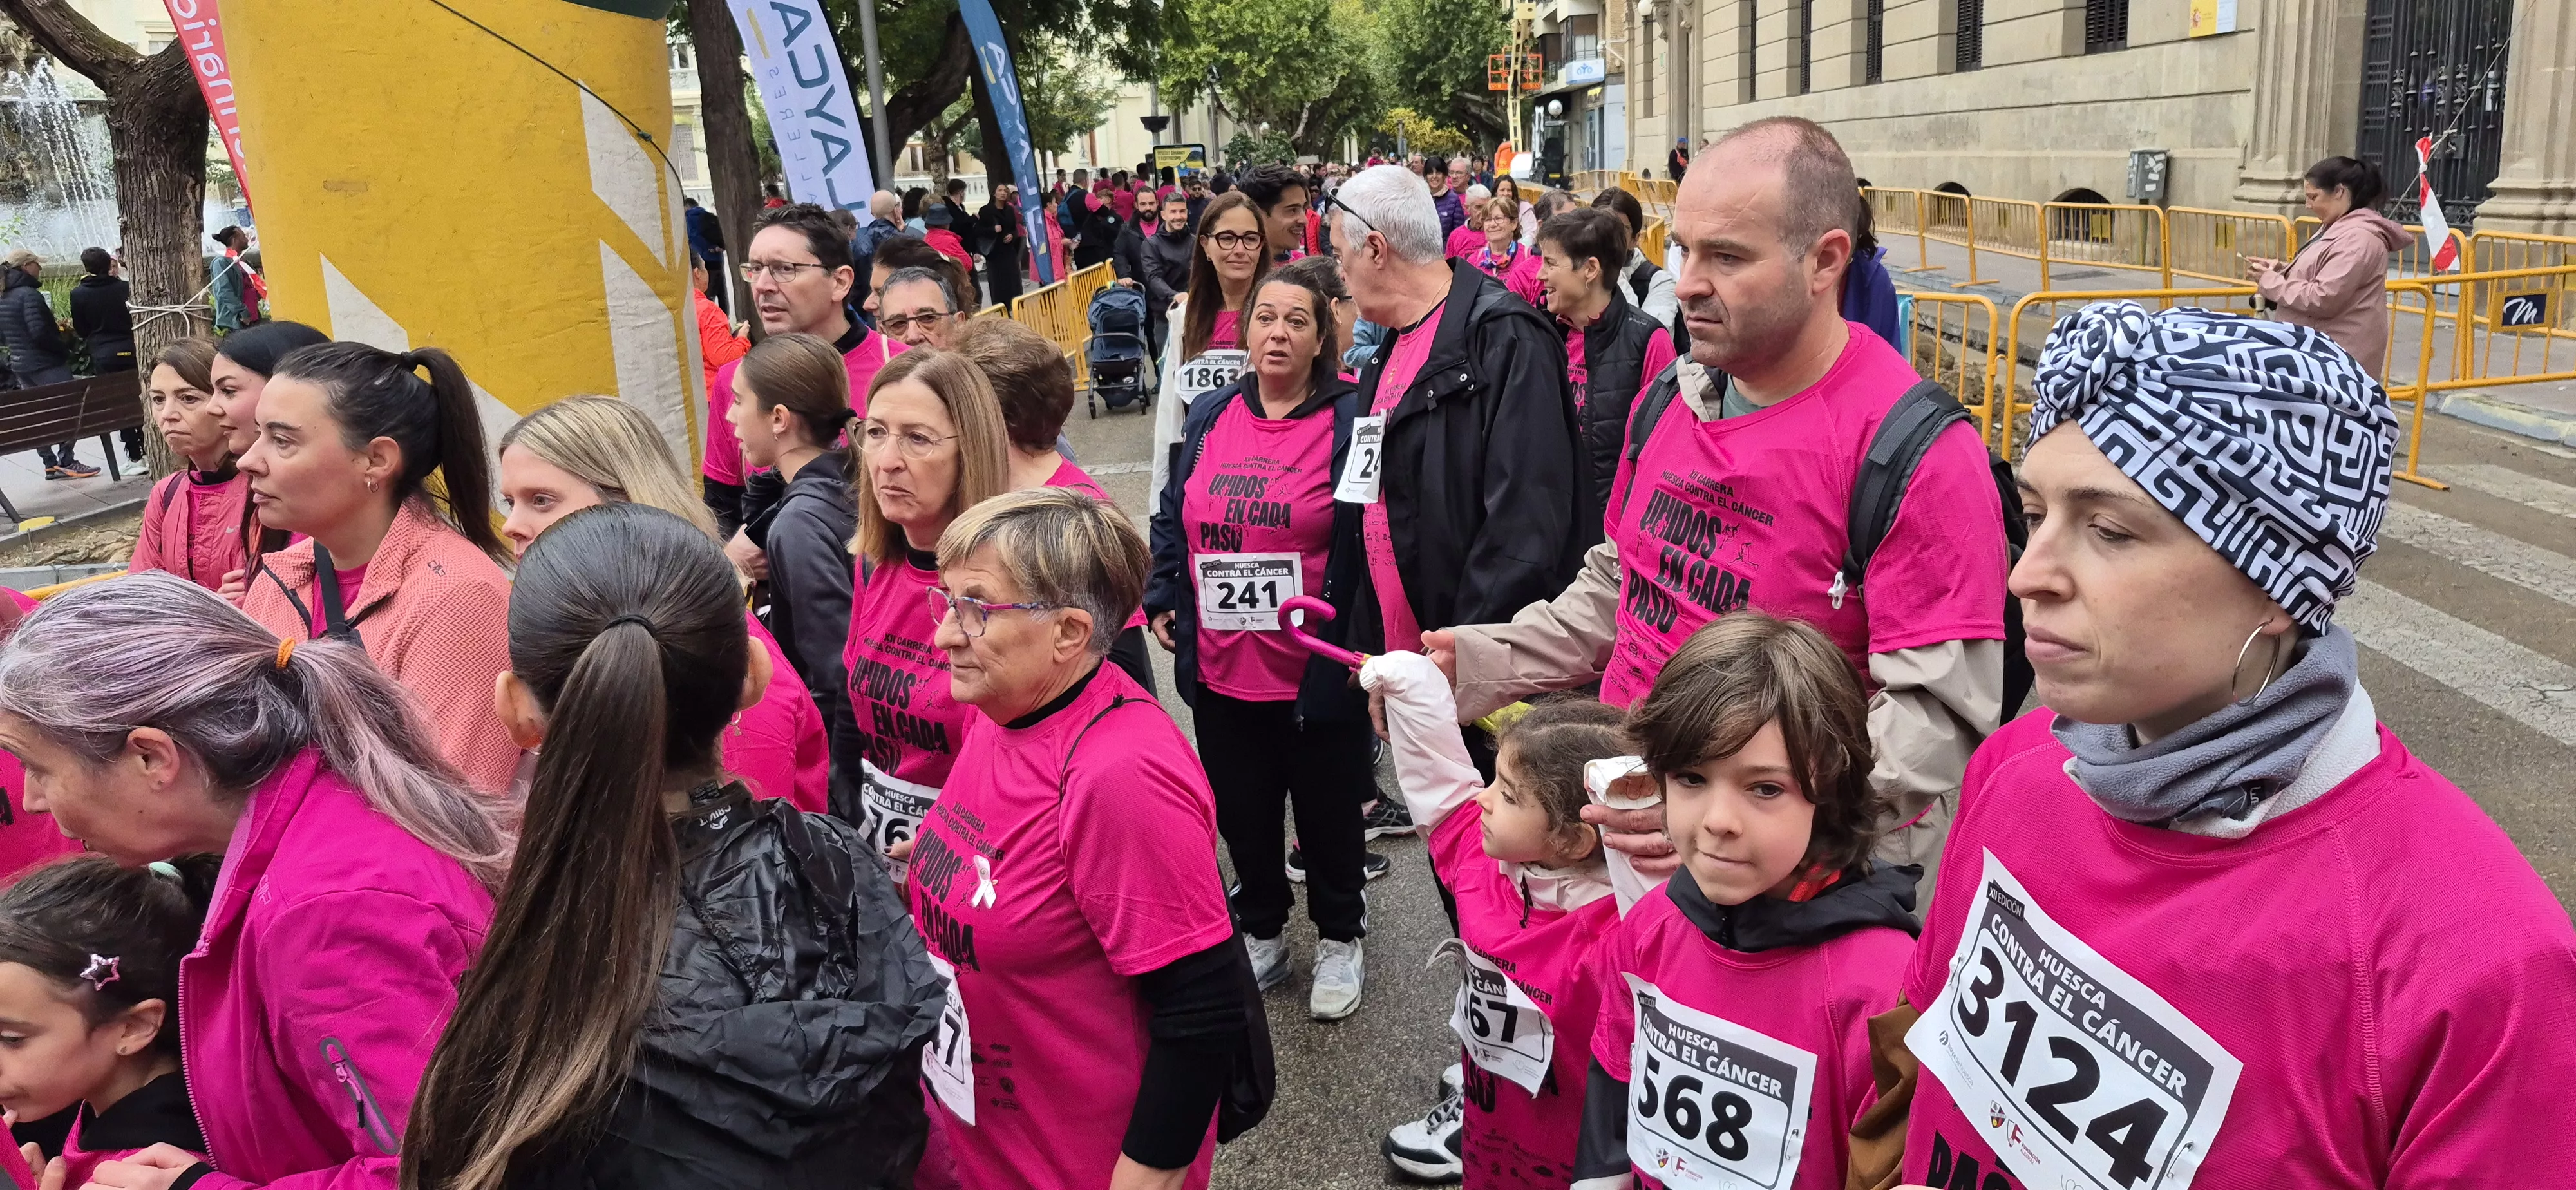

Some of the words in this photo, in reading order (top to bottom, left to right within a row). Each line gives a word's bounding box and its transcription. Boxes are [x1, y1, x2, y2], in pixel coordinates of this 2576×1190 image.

[1184, 368, 1239, 388] 1863
[1243, 463, 1267, 471] CONTRA
[1277, 464, 1302, 473] CÁNCER
[1251, 455, 1280, 465] CARRERA
[1208, 473, 1269, 499] UNIDOS
[1660, 468, 1683, 489] HUESCA
[1684, 481, 1715, 504] CONTRA
[1717, 496, 1729, 509] EL
[1731, 500, 1774, 527] CÁNCER
[1688, 469, 1700, 482] XII
[1696, 473, 1734, 498] CARRERA
[1224, 498, 1247, 524] EN
[1248, 500, 1291, 529] CADA
[1639, 489, 1722, 560] UNIDOS
[1200, 521, 1243, 552] PASO
[1255, 567, 1289, 576] CÁNCER
[1653, 544, 1690, 593] EN
[1687, 559, 1751, 612] CADA
[1217, 581, 1278, 609] 241
[1625, 567, 1678, 634] PASO
[883, 633, 897, 643] XII
[897, 636, 933, 655] CARRERA
[885, 645, 916, 661] CONTRA
[916, 654, 926, 666] EL
[850, 654, 916, 710] UNIDOS
[871, 701, 899, 740] EN
[896, 710, 951, 755] CADA
[863, 732, 902, 777] ASO
[862, 782, 893, 809] CONTRA
[893, 802, 906, 813] EL
[885, 789, 916, 804] HUESCA
[947, 817, 970, 844] CONTRA
[967, 832, 977, 847] EL
[959, 806, 986, 835] CARRERA
[910, 827, 963, 904] UNIDOS
[1988, 886, 1998, 902] XII
[1997, 892, 2023, 918] EDICIÓN
[920, 888, 936, 943] EN
[934, 903, 981, 972] CADA
[2038, 948, 2106, 1011] HUESCA
[1464, 992, 1519, 1044] 67
[1991, 913, 2045, 996] CONTRA
[2048, 983, 2075, 1019] EL
[2082, 1009, 2188, 1099] CÁNCER
[1668, 1022, 1719, 1055] HUESCA
[1643, 1012, 1678, 1057] CONTRA
[1681, 1044, 1700, 1068] EL
[1705, 1057, 1783, 1099] CÁNCER
[1956, 945, 2169, 1184] 3124
[1637, 1048, 1753, 1162] 568
[2020, 1148, 2035, 1166] ALCORAZ
[2022, 1143, 2041, 1165] FUNDACIÓN
